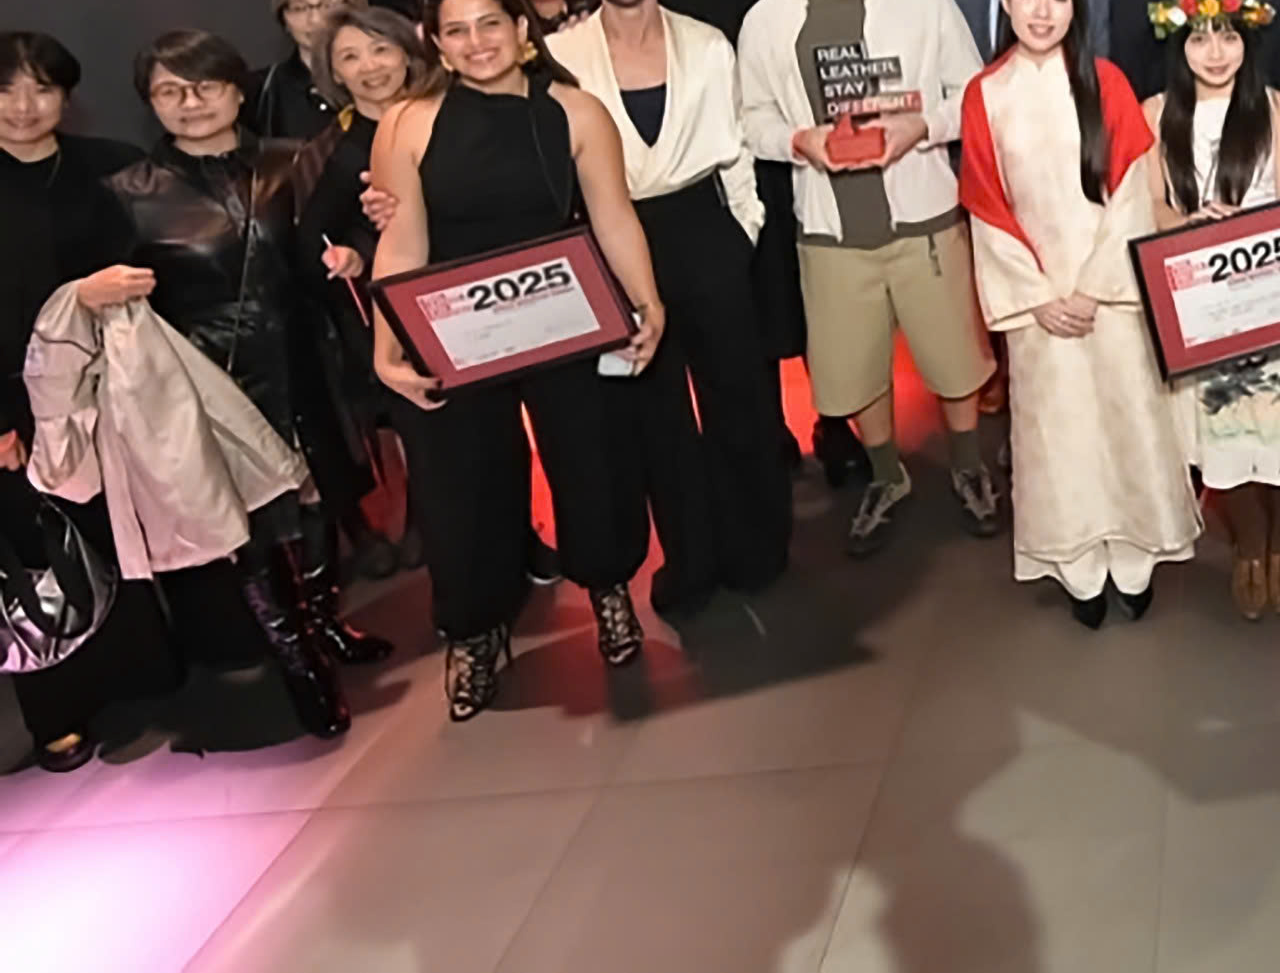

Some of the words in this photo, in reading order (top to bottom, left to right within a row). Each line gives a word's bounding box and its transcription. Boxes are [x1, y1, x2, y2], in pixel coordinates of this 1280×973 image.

[817, 45, 860, 62] REAL
[824, 81, 864, 98] STAY
[467, 263, 571, 311] 2025
